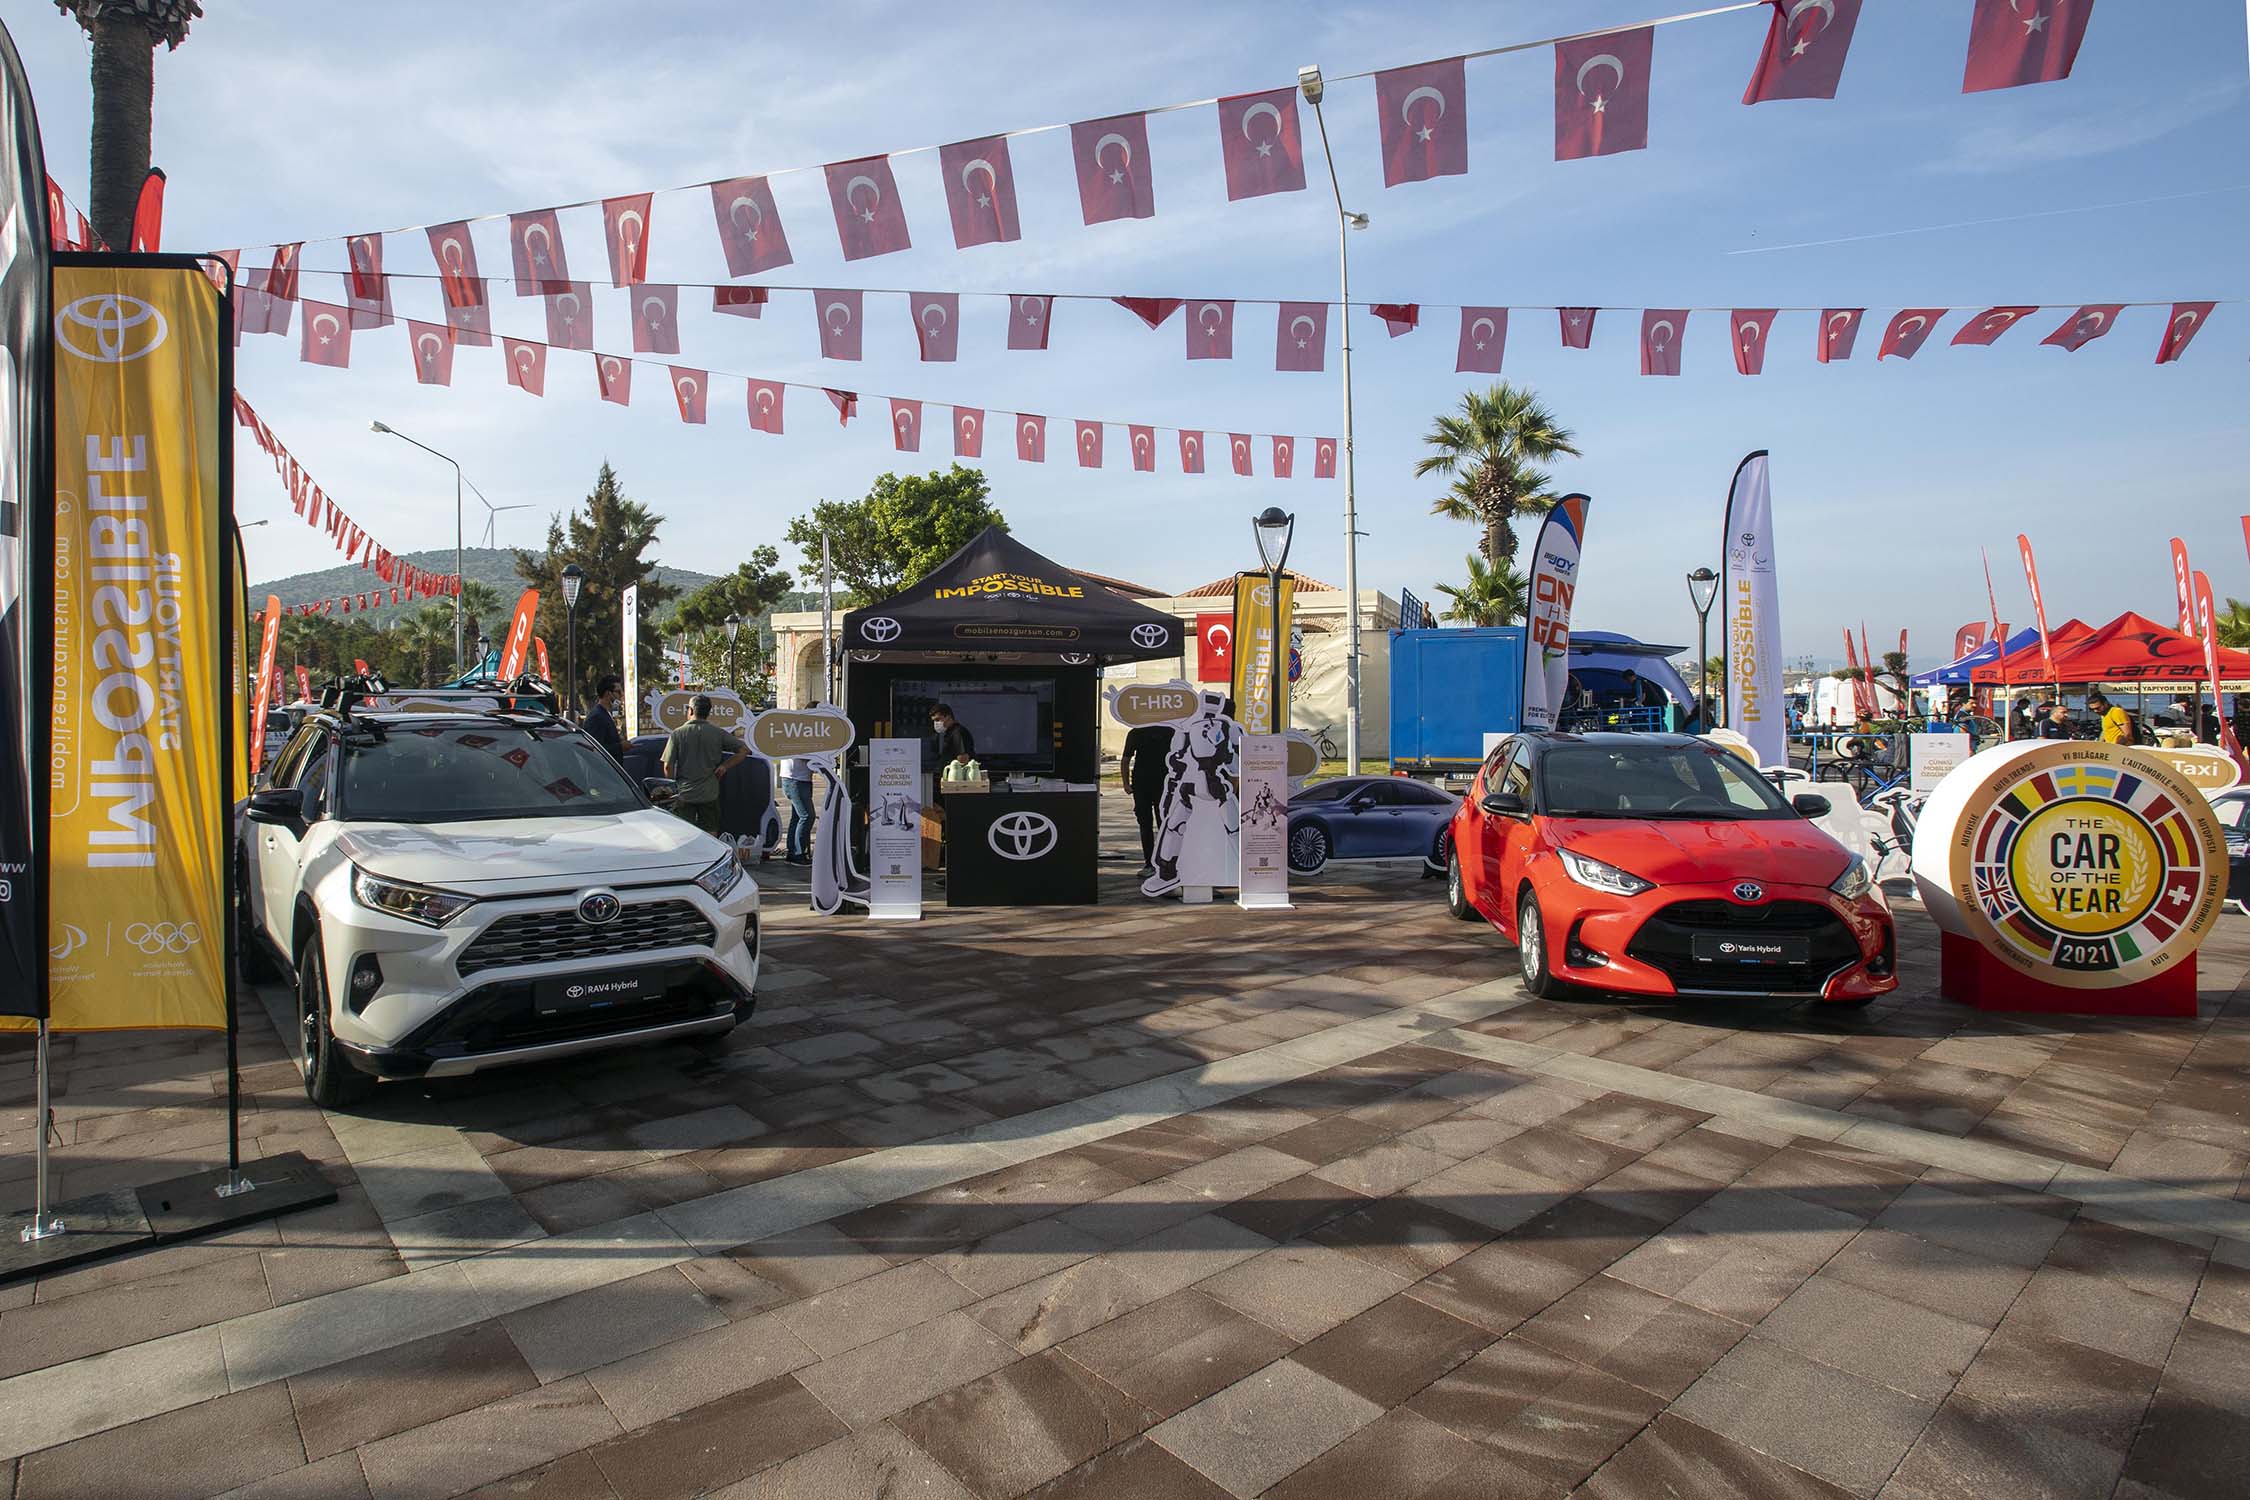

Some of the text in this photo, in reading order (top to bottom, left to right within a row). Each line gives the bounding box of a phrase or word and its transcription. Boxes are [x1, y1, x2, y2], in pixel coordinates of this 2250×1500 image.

[935, 579, 1085, 599] IMPOSSIBLE
[972, 572, 1042, 585] START YOUR
[1536, 573, 1575, 610] ON
[1533, 615, 1569, 650] GO
[1731, 617, 1740, 648] YOUR
[1738, 580, 1761, 722] IMPOSSIBLE
[1247, 664, 1255, 692] YOUR
[1129, 694, 1184, 710] T-HR3
[769, 721, 832, 738] i-Walk
[1992, 761, 2036, 792] AUTO TRENDS
[2121, 757, 2173, 787] L'AUTOMOBILE
[2171, 760, 2218, 777] Taxi
[1960, 814, 1980, 848] AUTOVISIE
[2065, 819, 2103, 829] THE
[2198, 818, 2217, 854] AUTOPISTA
[2050, 832, 2121, 870] CAR
[2050, 872, 2121, 884] OF THE
[2206, 874, 2219, 896] REVUE
[2050, 887, 2121, 913] YEAR
[1738, 944, 1781, 954] Yaris Hybrid
[2061, 944, 2110, 965] 2021
[2150, 952, 2170, 967] AUTO
[587, 979, 638, 994] RAV4 Hybrid
